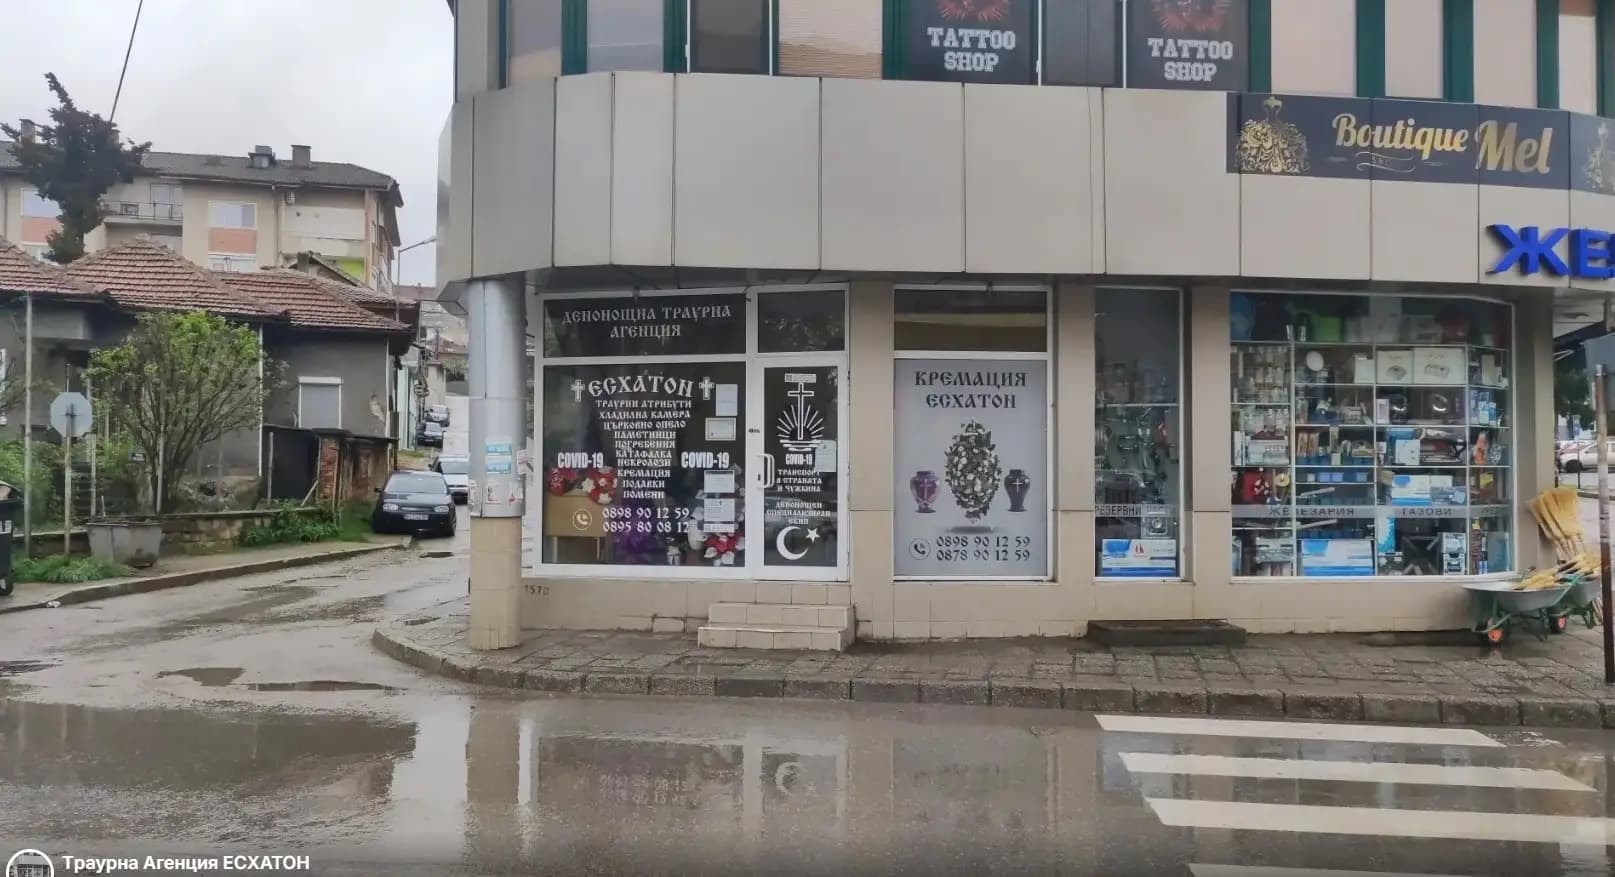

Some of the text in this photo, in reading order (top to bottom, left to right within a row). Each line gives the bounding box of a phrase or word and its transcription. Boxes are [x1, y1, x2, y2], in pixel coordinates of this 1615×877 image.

[927, 27, 1016, 50] TATTOO
[1147, 37, 1233, 60] TATTOO
[943, 52, 999, 73] SHOP
[1163, 61, 1217, 82] SHOP
[1332, 112, 1553, 175] Boutique Mel
[1486, 223, 1615, 280] ЖЕ
[661, 304, 732, 322] ТРАУРНА
[610, 324, 681, 340] АГЕНЦИЯ
[588, 375, 694, 398] ЕСХАТОН
[914, 370, 1027, 388] КРЕМАЦИЯ
[596, 400, 692, 409] ТРАУРНИ АТРИБУТИ
[926, 393, 1016, 409] ЕСХАТОН
[599, 410, 691, 420] ХЛАДИЛНА КАМЕРА
[614, 431, 676, 440] ПАМЕТНИЦИ
[615, 440, 676, 449] ПОГРЕБЕНИЯ
[557, 452, 604, 469] COVID-19
[681, 451, 729, 469] COVID-19
[785, 453, 813, 465] COVID-19
[617, 469, 671, 479] КРЕМАЦИЯ
[602, 508, 690, 518] 0898 90 12 59
[602, 522, 689, 532] 0895 80 08 12
[936, 536, 1030, 547] 0898 90 12 59
[936, 550, 1030, 561] 0878 90 12 59
